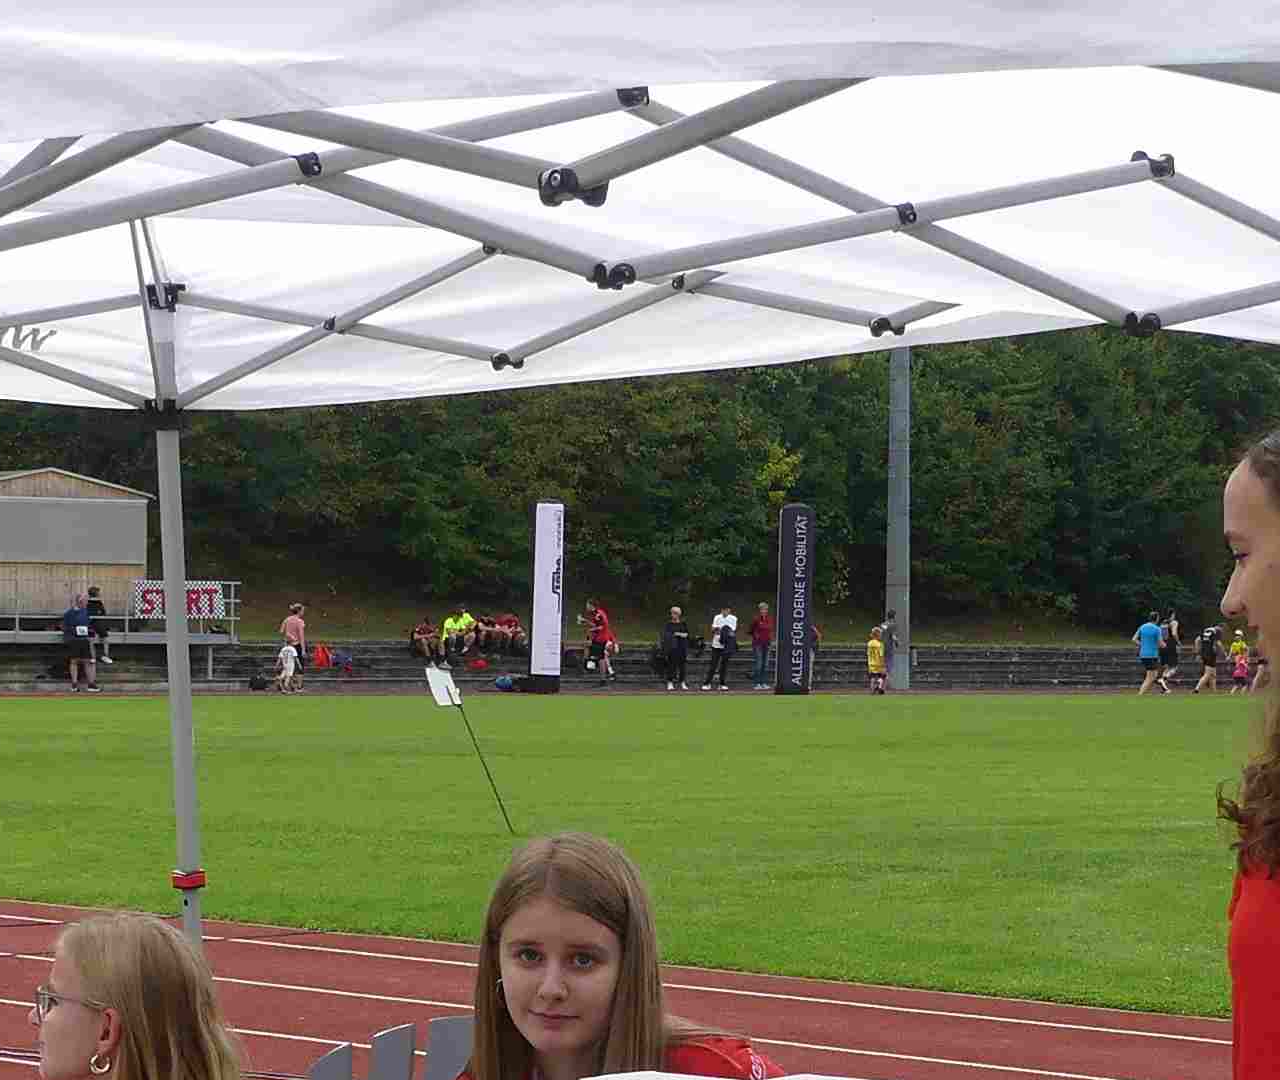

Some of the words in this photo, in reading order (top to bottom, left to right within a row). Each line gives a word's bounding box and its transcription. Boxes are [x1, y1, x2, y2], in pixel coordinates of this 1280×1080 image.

[793, 514, 809, 579] MOBILITÄT
[143, 587, 219, 616] STRT
[792, 581, 806, 619] DEINE
[791, 622, 805, 646] FÜR
[791, 648, 804, 686] ALLES
